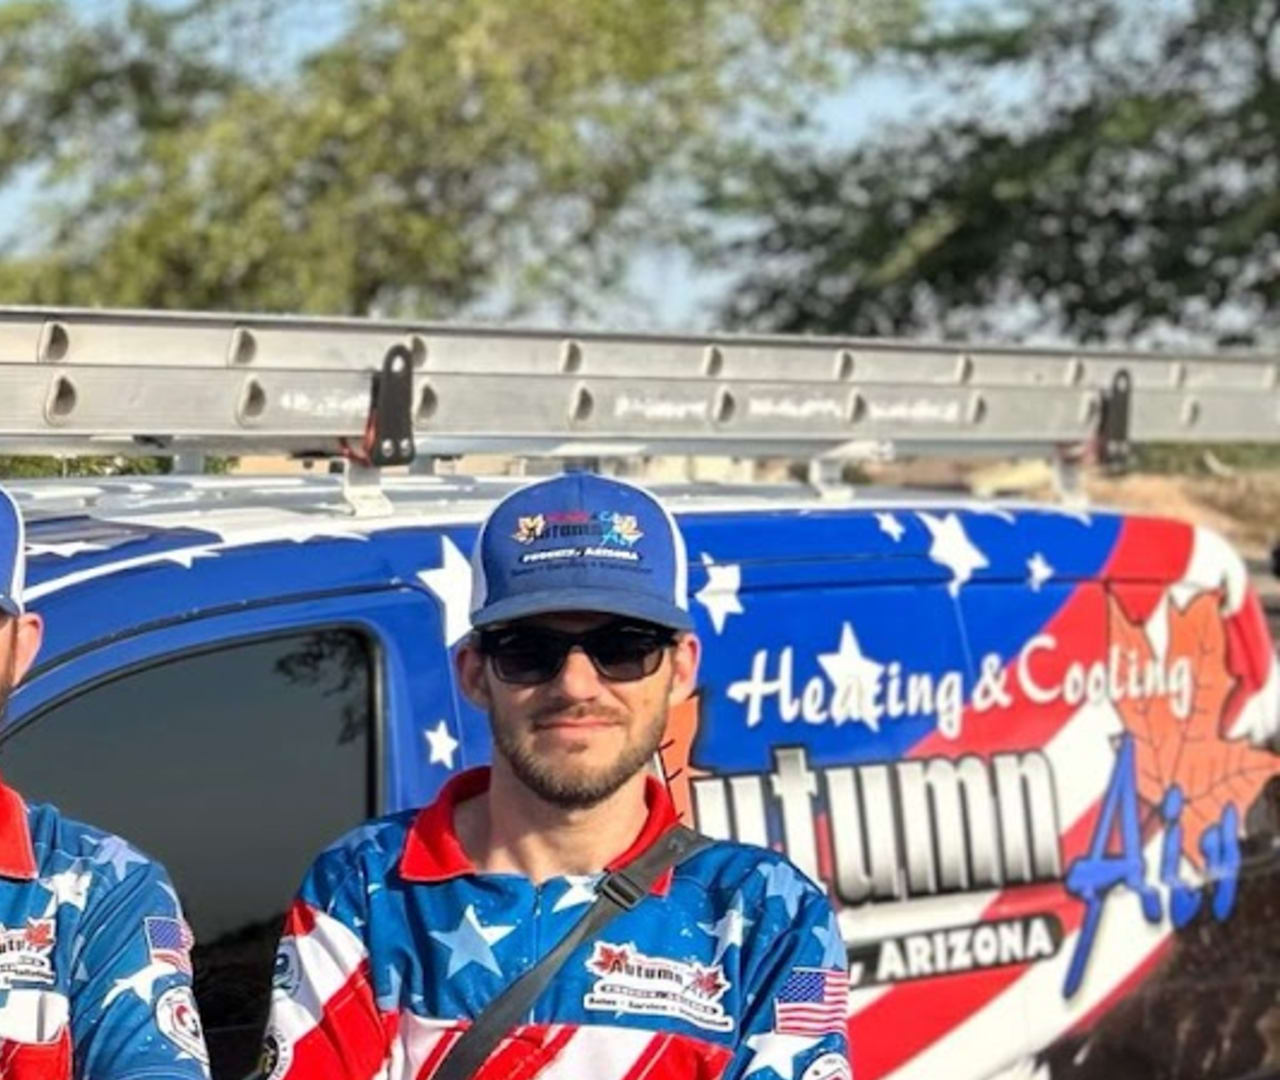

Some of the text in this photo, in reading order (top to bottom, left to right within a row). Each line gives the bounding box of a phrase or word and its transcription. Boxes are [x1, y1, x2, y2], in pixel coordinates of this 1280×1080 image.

[727, 635, 1193, 737] Heating & Cooling
[875, 918, 1055, 982] ARIZONA
